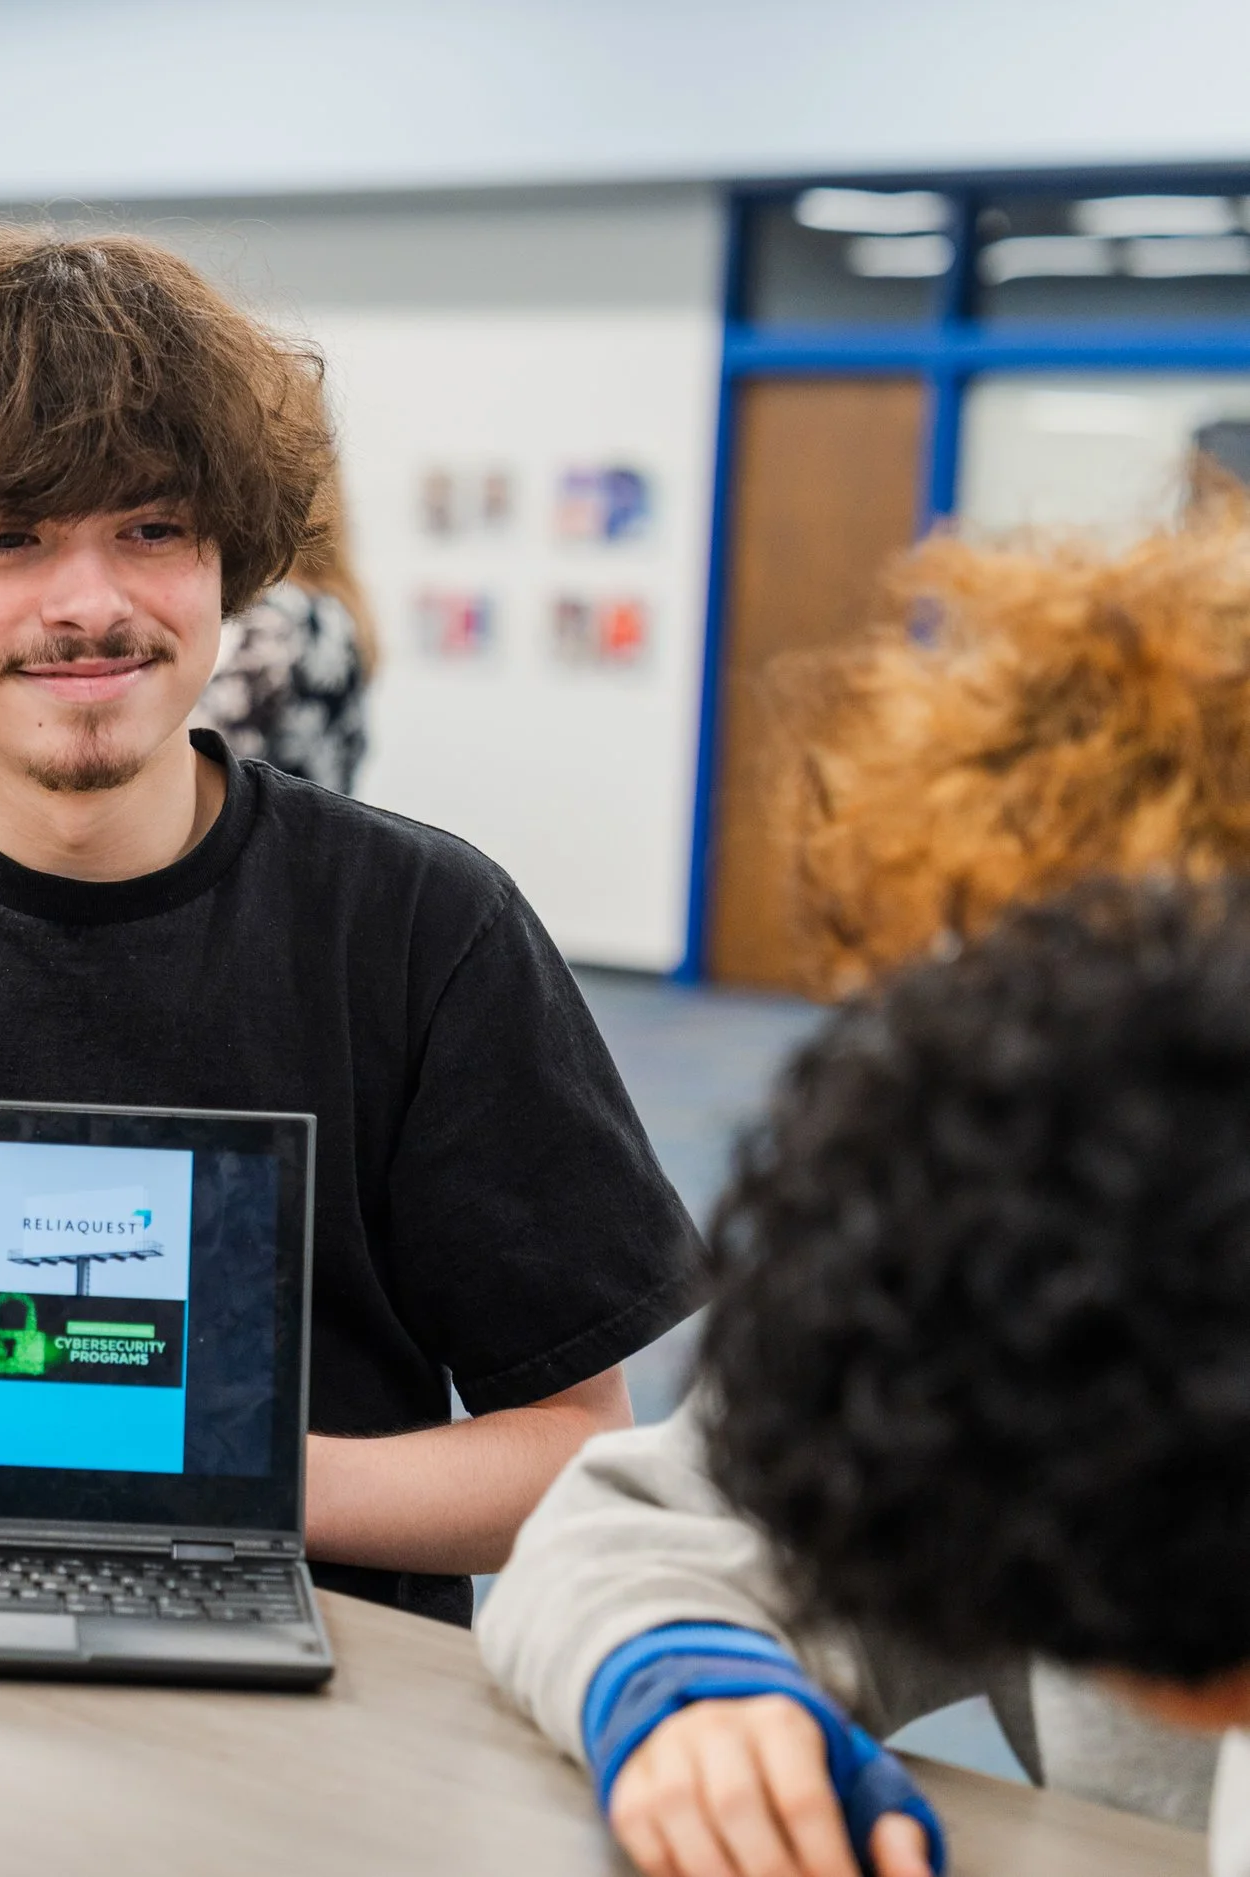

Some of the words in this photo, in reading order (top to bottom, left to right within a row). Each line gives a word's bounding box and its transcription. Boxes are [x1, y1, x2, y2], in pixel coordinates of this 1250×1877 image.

[22, 1217, 136, 1235] RELIAQUEST
[54, 1336, 166, 1353] CYBERSECURITY
[70, 1350, 150, 1366] PROGRAMS
